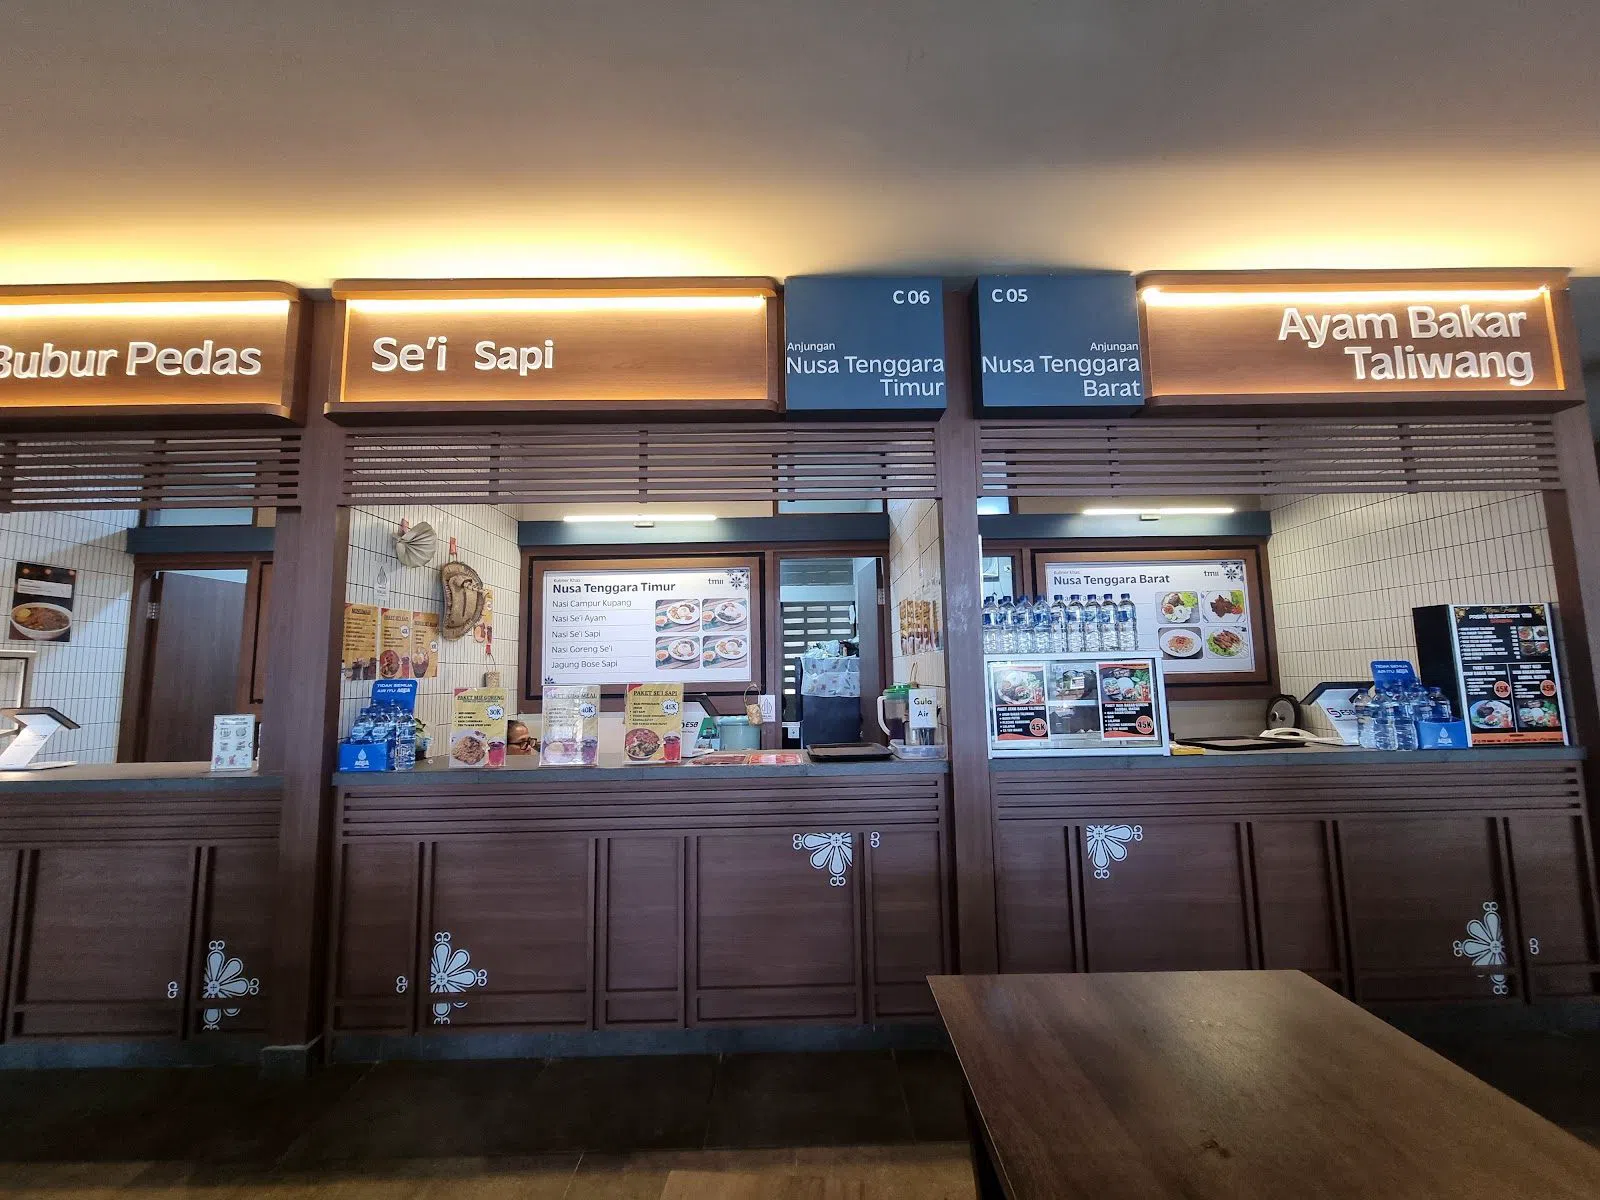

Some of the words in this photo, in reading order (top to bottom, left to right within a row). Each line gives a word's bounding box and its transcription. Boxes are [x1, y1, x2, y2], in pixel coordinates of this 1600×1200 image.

[892, 290, 905, 304] C
[907, 290, 931, 304] 06
[991, 288, 1004, 303] C
[1006, 288, 1029, 303] 05
[1277, 307, 1398, 349] Ayam
[1407, 304, 1527, 340] Bakar
[787, 342, 836, 353] Anjungan
[1090, 342, 1139, 353] Anjungan
[125, 339, 262, 377] Pedas
[474, 339, 554, 377] Sapi
[787, 356, 840, 374] Nusa
[843, 355, 945, 378] Tenggara
[982, 356, 1035, 373] Nusa
[1039, 355, 1140, 377] Tenggara
[1343, 345, 1535, 387] Taliwang
[879, 378, 945, 397] Timur
[1083, 379, 1141, 397] Barat
[1053, 575, 1082, 585] Nusa
[1083, 574, 1137, 587] Tenggara
[1139, 574, 1171, 584] Barat
[553, 583, 582, 594] Nusa
[583, 582, 639, 595] Tenggara
[640, 582, 676, 592] Timur
[552, 600, 568, 608] Nasi
[570, 599, 600, 610] Campur
[602, 598, 632, 610] Kupang
[584, 614, 607, 623] Ayam
[584, 630, 601, 639] Sapi
[569, 645, 598, 654] Goreng
[551, 661, 579, 670] Jagung
[581, 660, 600, 668] Bose
[601, 659, 618, 668] Sapi
[913, 697, 933, 706] Gula
[1031, 723, 1046, 731] 45K
